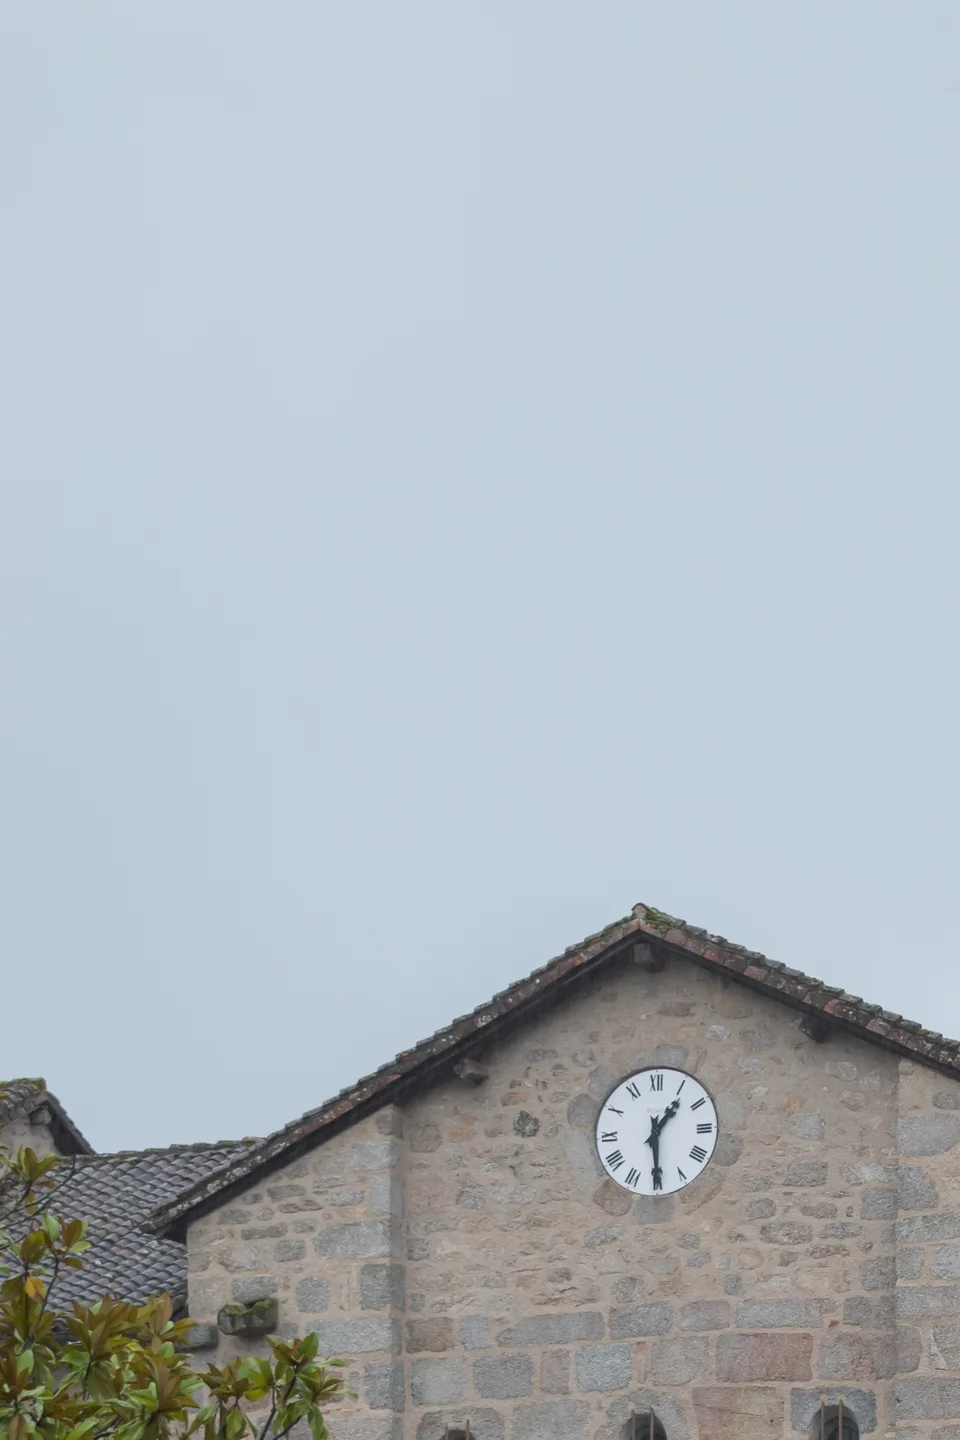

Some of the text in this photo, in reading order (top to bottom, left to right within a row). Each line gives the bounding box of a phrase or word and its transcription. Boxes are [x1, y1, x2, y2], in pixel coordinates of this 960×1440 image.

[650, 1074, 663, 1091] XII
[626, 1082, 641, 1101] XI
[608, 1105, 624, 1117] X
[690, 1097, 706, 1111] II
[602, 1131, 618, 1142] IX
[696, 1123, 712, 1134] III
[606, 1150, 625, 1172] VIII
[625, 1168, 641, 1187] VII
[677, 1166, 687, 1182] V
